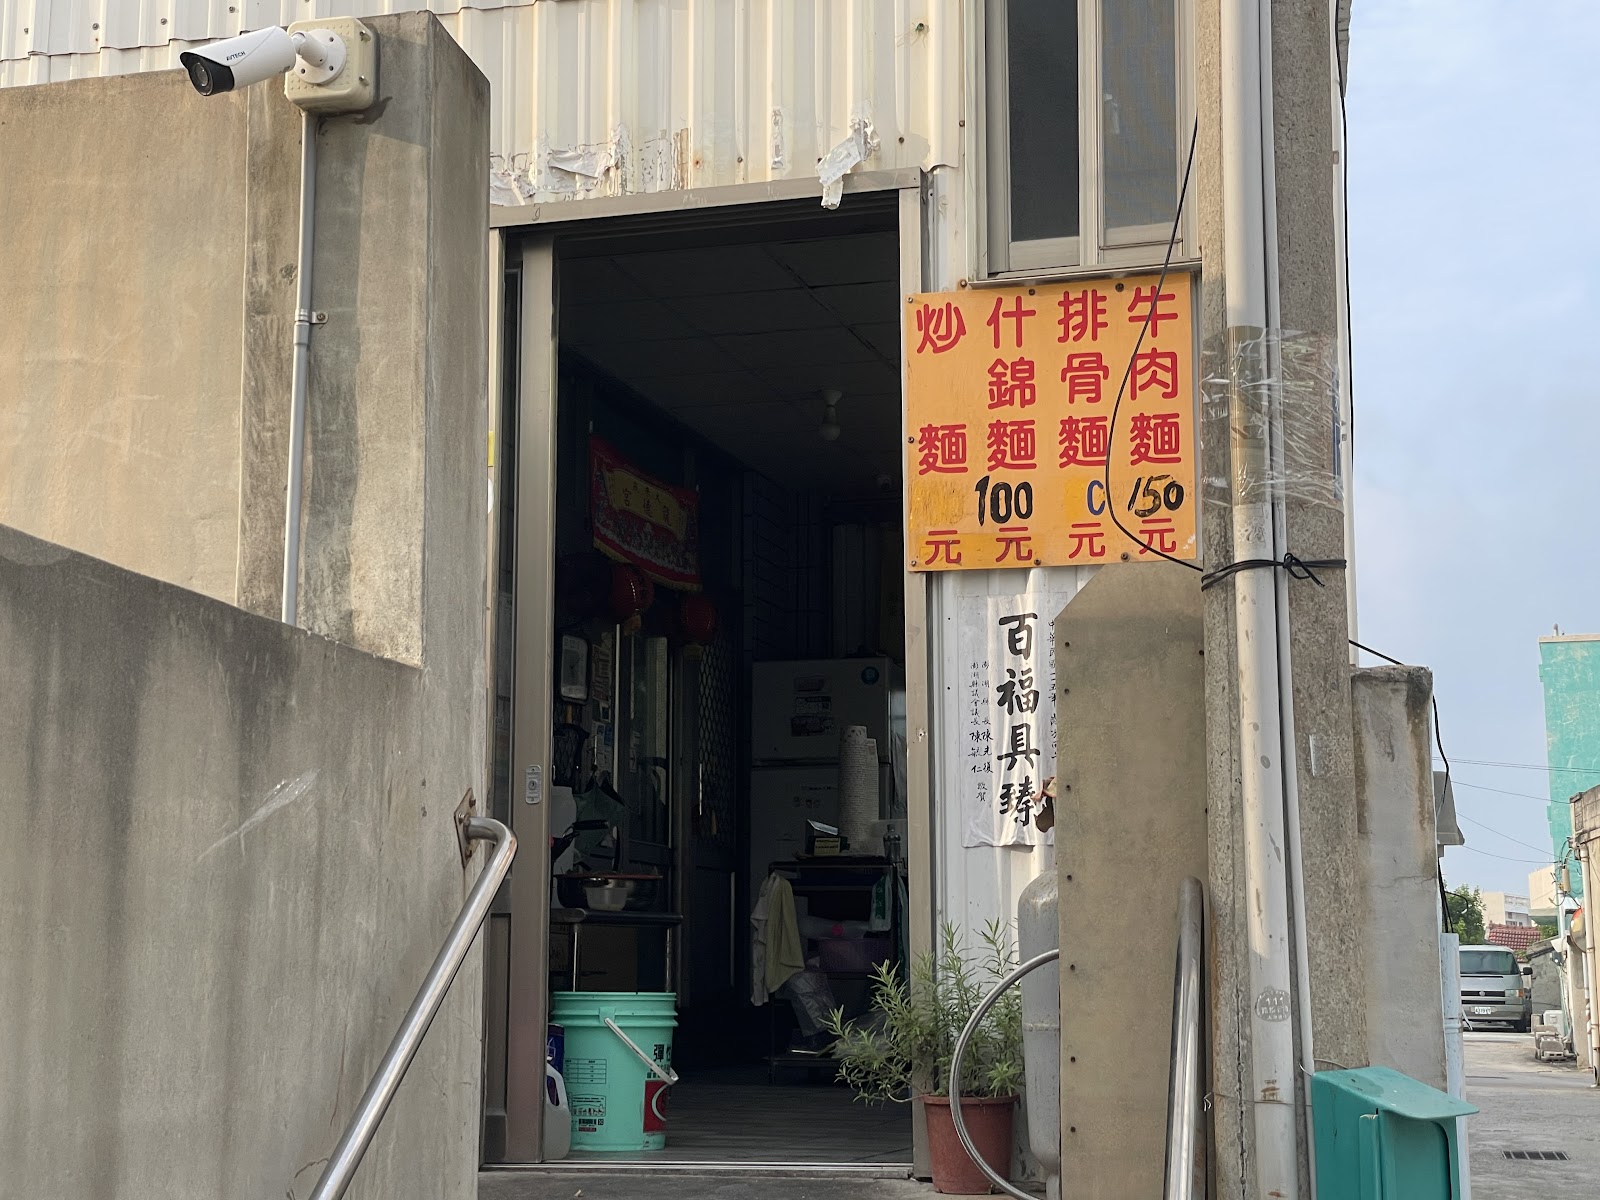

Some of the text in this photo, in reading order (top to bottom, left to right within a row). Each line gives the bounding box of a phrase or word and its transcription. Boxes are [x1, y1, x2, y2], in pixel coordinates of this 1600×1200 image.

[916, 302, 968, 565] 炒麵 元
[975, 296, 1037, 563] 什錦麵 100 元
[1057, 289, 1109, 468] 排骨麵
[1127, 285, 1184, 555] 牛肉麵 150 元
[1068, 522, 1106, 558] 元
[996, 612, 1040, 827] 百福具臻
